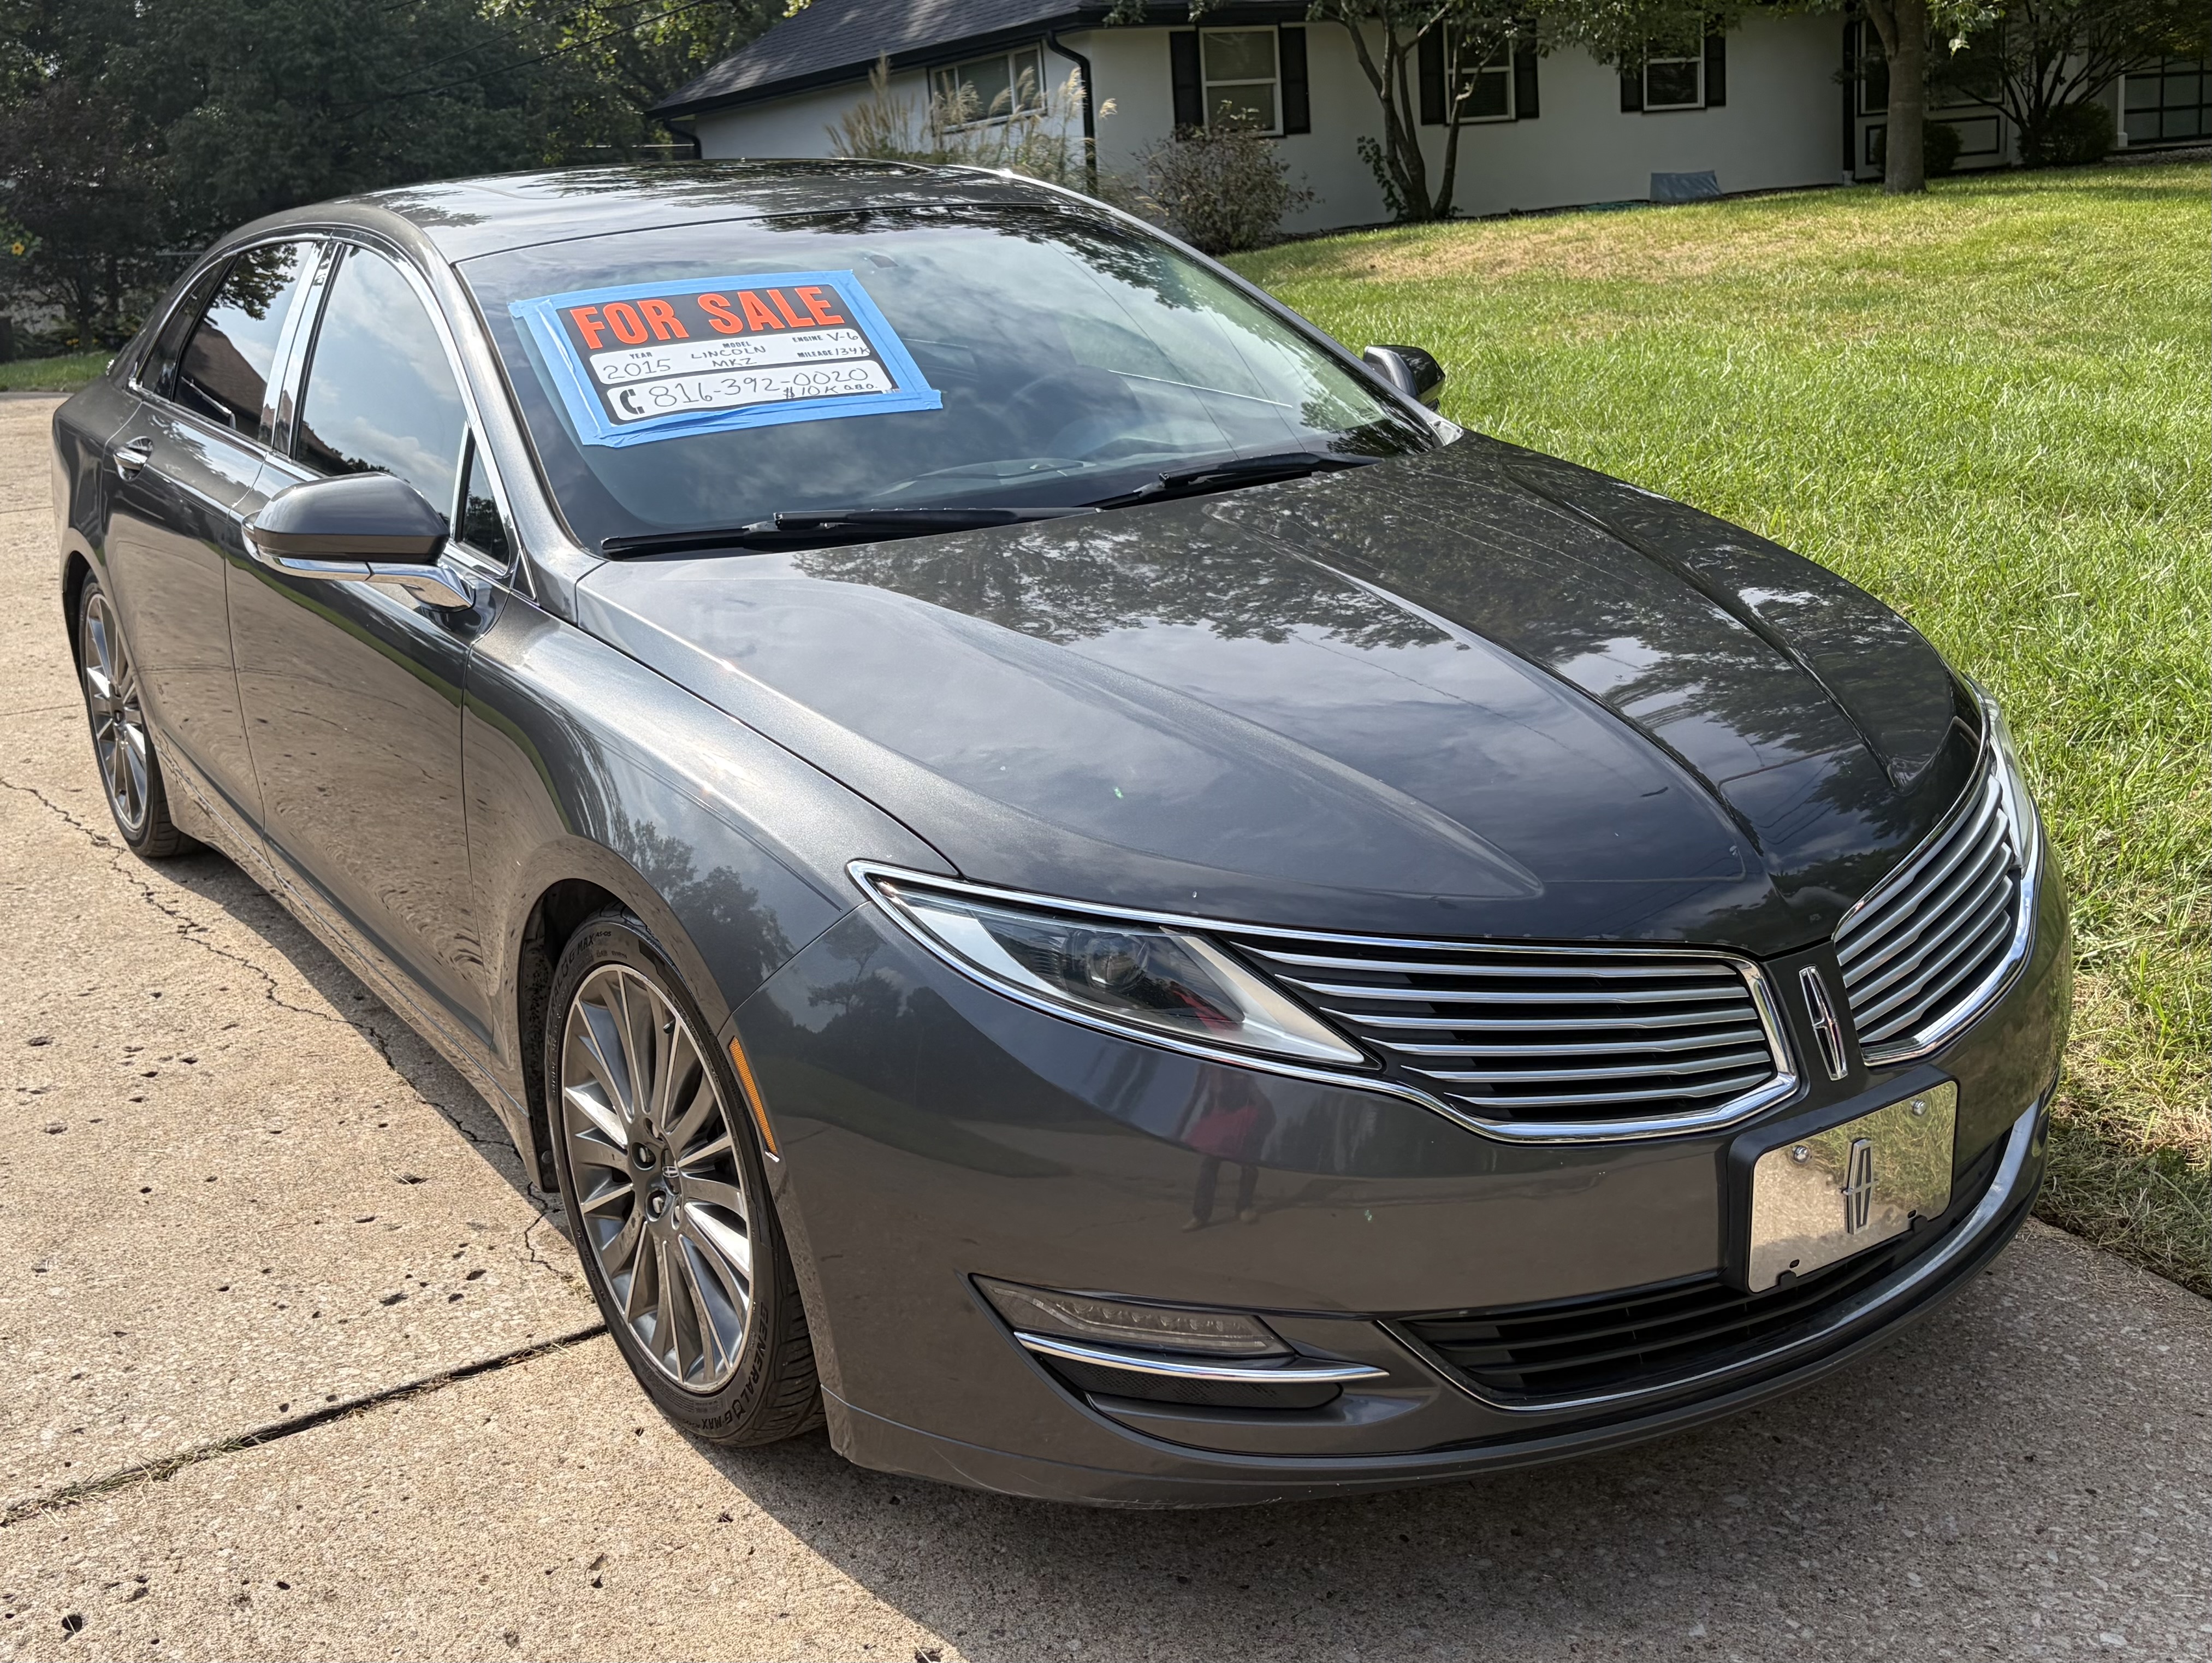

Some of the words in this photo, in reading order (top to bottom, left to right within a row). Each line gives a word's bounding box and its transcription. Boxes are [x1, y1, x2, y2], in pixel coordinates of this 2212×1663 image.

[570, 299, 690, 350] FOR
[697, 287, 845, 334] SALE
[827, 332, 858, 341] V-6
[691, 345, 766, 359] LINCOLN
[797, 350, 834, 358] MILEAGE
[835, 347, 870, 356] 134K
[603, 358, 671, 380] 2015
[712, 357, 757, 367] MKZ
[649, 368, 868, 407] 816-392-0020
[741, 1301, 769, 1403] GENERAL
